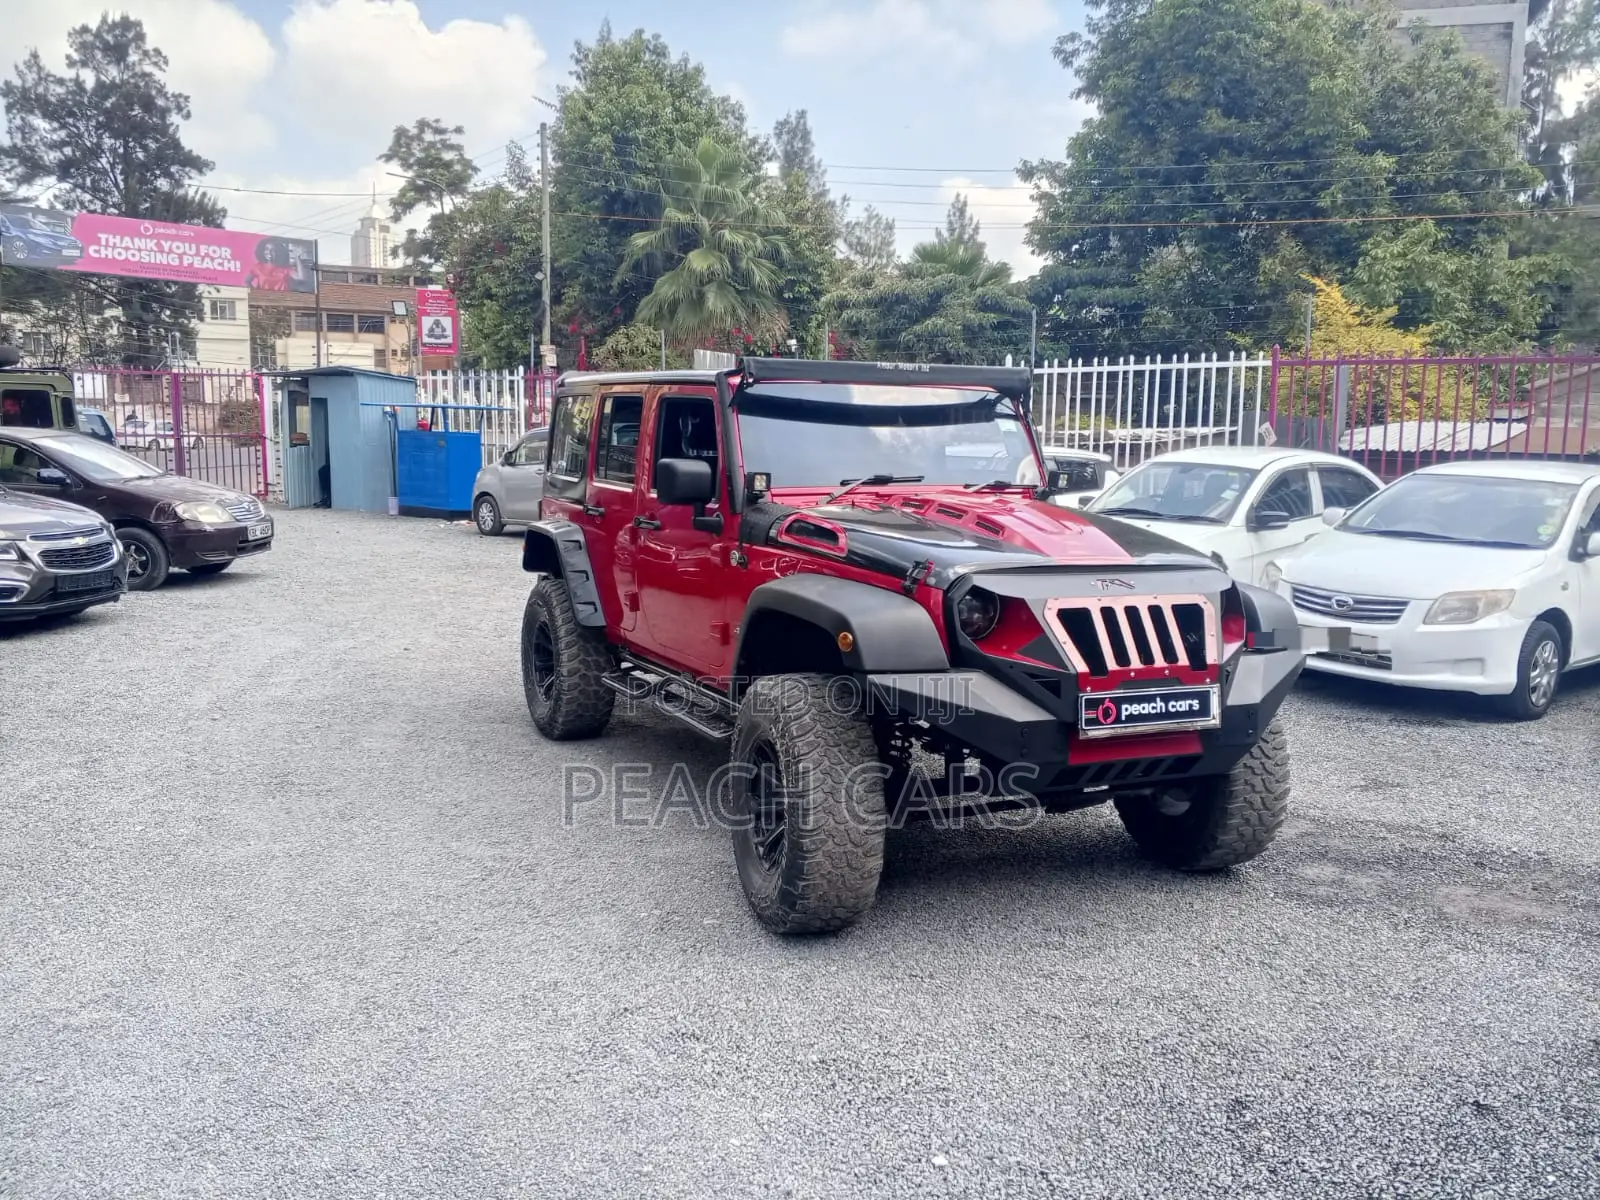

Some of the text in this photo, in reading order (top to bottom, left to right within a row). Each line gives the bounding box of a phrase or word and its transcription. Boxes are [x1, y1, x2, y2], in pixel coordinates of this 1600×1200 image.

[88, 245, 180, 266] CHOOSING
[183, 255, 241, 273] PEACH!
[97, 233, 232, 259] THANK YOU FOR
[1121, 697, 1200, 720] peach cars
